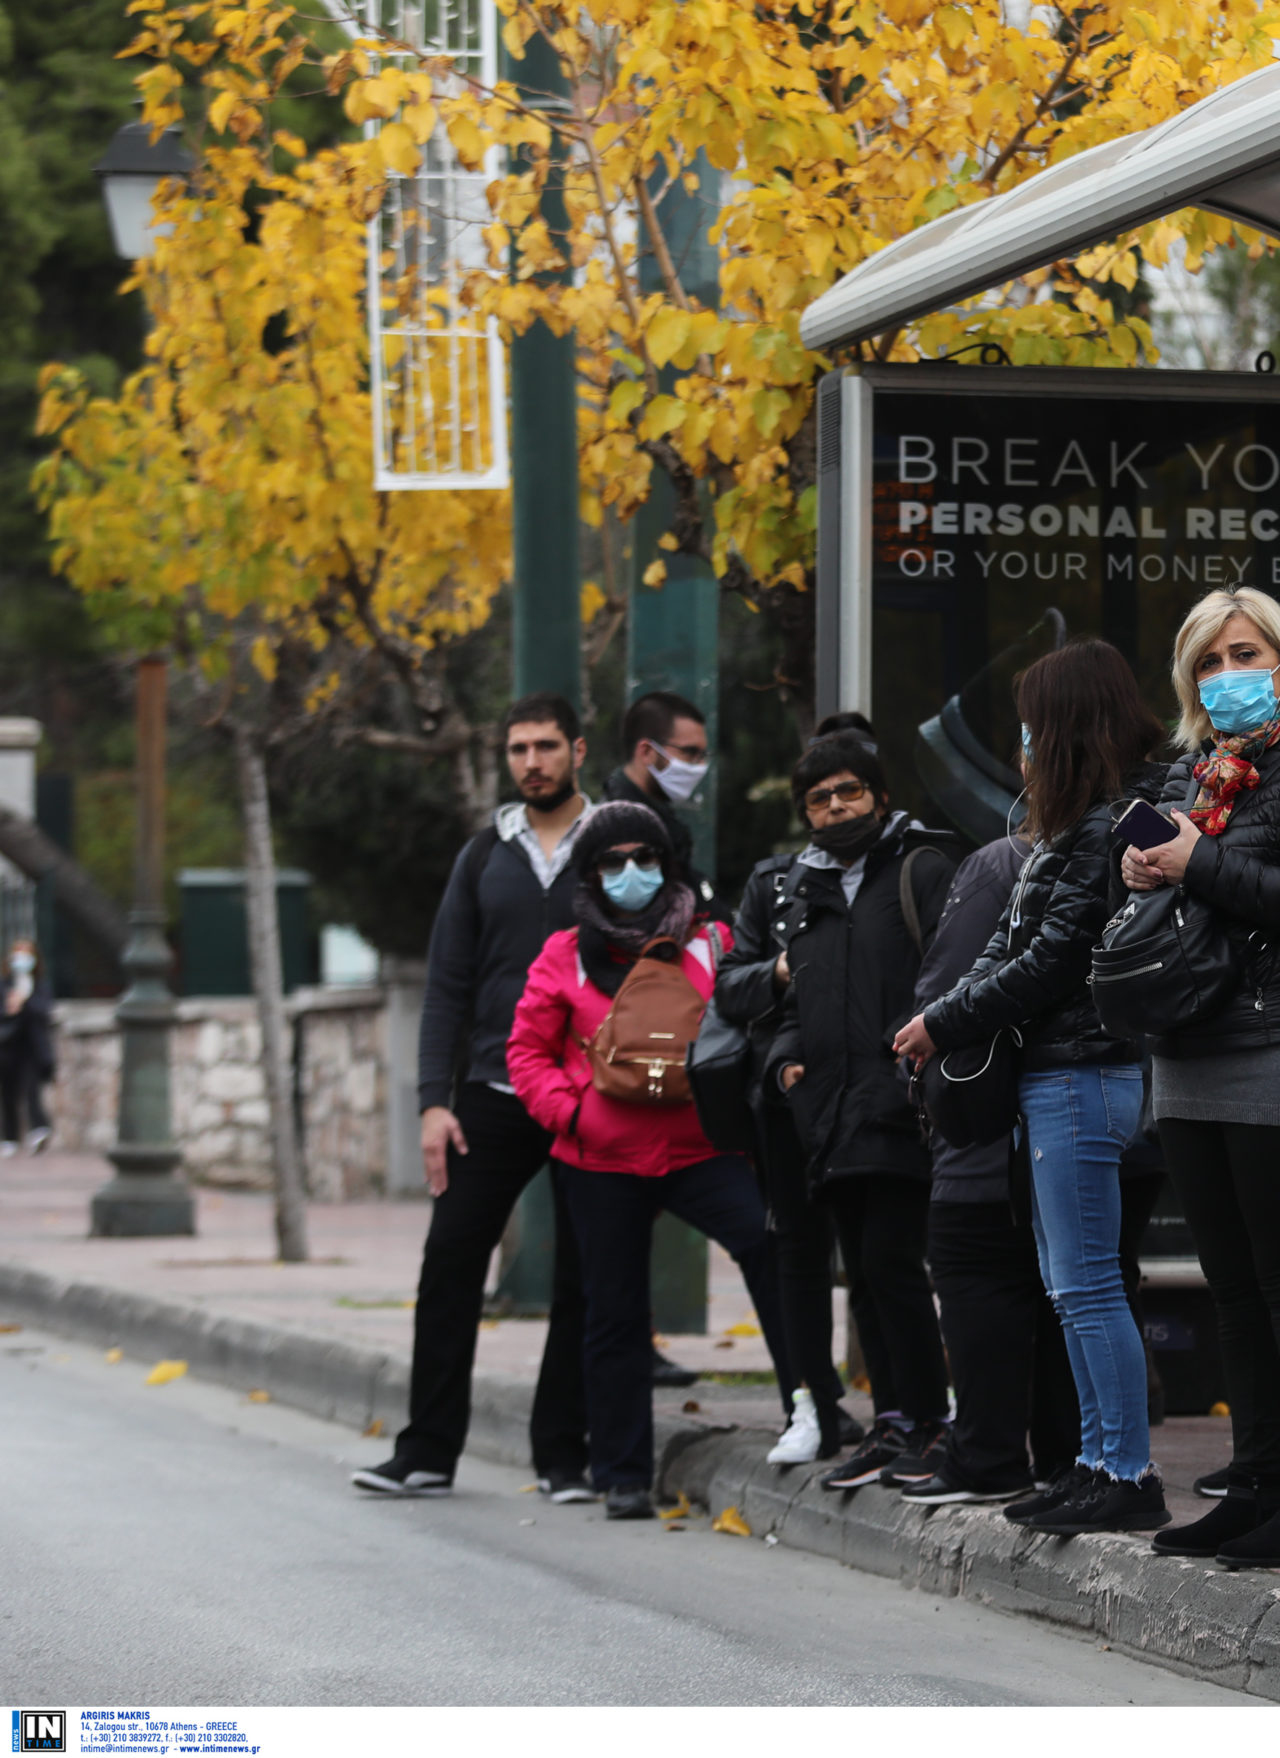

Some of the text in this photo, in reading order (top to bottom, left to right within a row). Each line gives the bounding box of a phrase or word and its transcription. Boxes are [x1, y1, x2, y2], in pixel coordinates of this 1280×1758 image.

[898, 435, 1149, 489] BREAK
[898, 501, 1167, 539] PERSONAL
[899, 549, 956, 578] OR
[974, 551, 1088, 581] YOUR
[1106, 553, 1252, 583] MONEY
